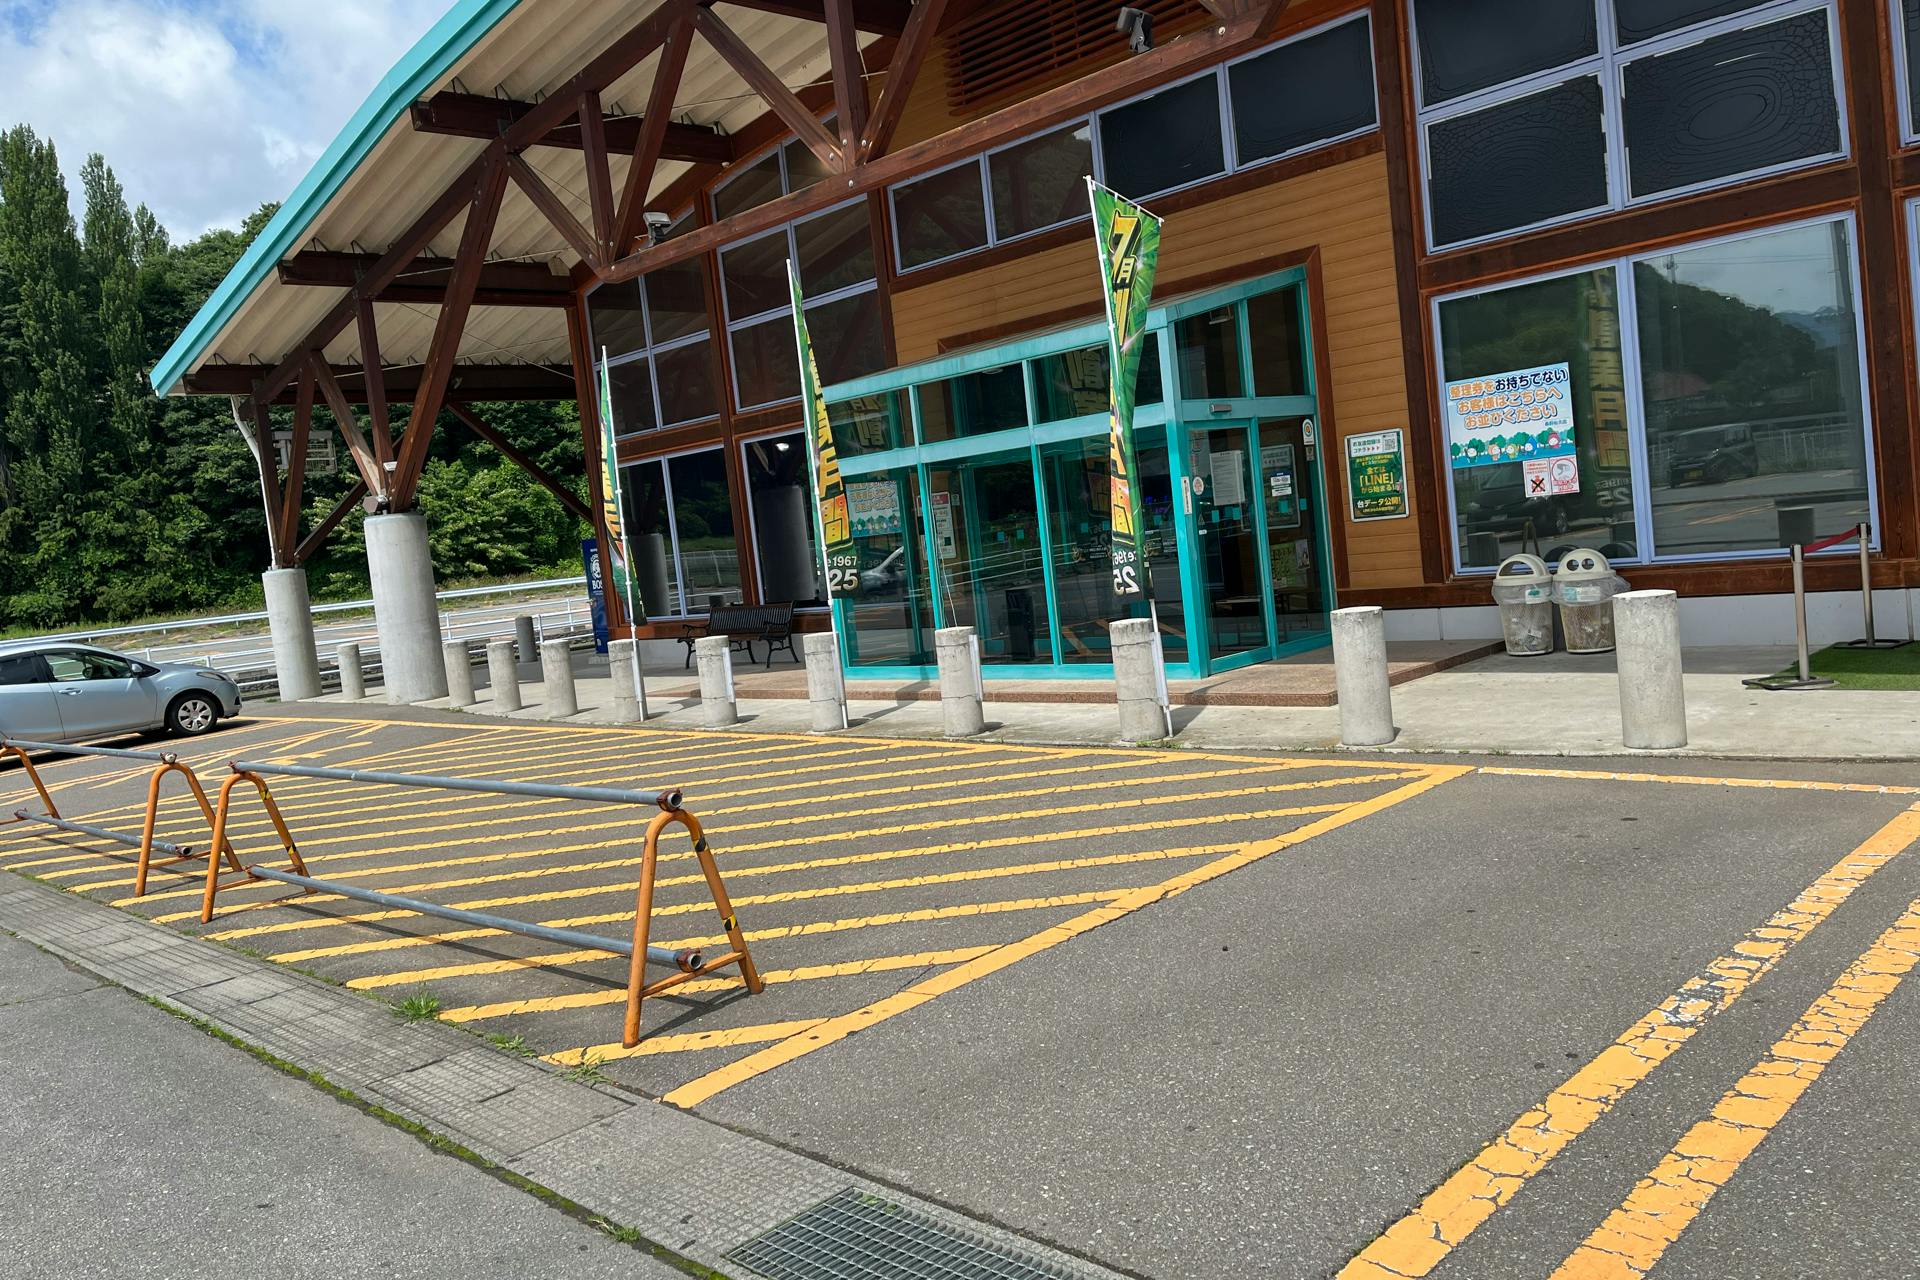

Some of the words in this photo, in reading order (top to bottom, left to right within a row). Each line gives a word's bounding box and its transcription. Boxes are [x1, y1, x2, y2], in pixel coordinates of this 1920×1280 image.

[1458, 386, 1564, 414] お客様はこちらへ
[1464, 403, 1558, 430] お並びください
